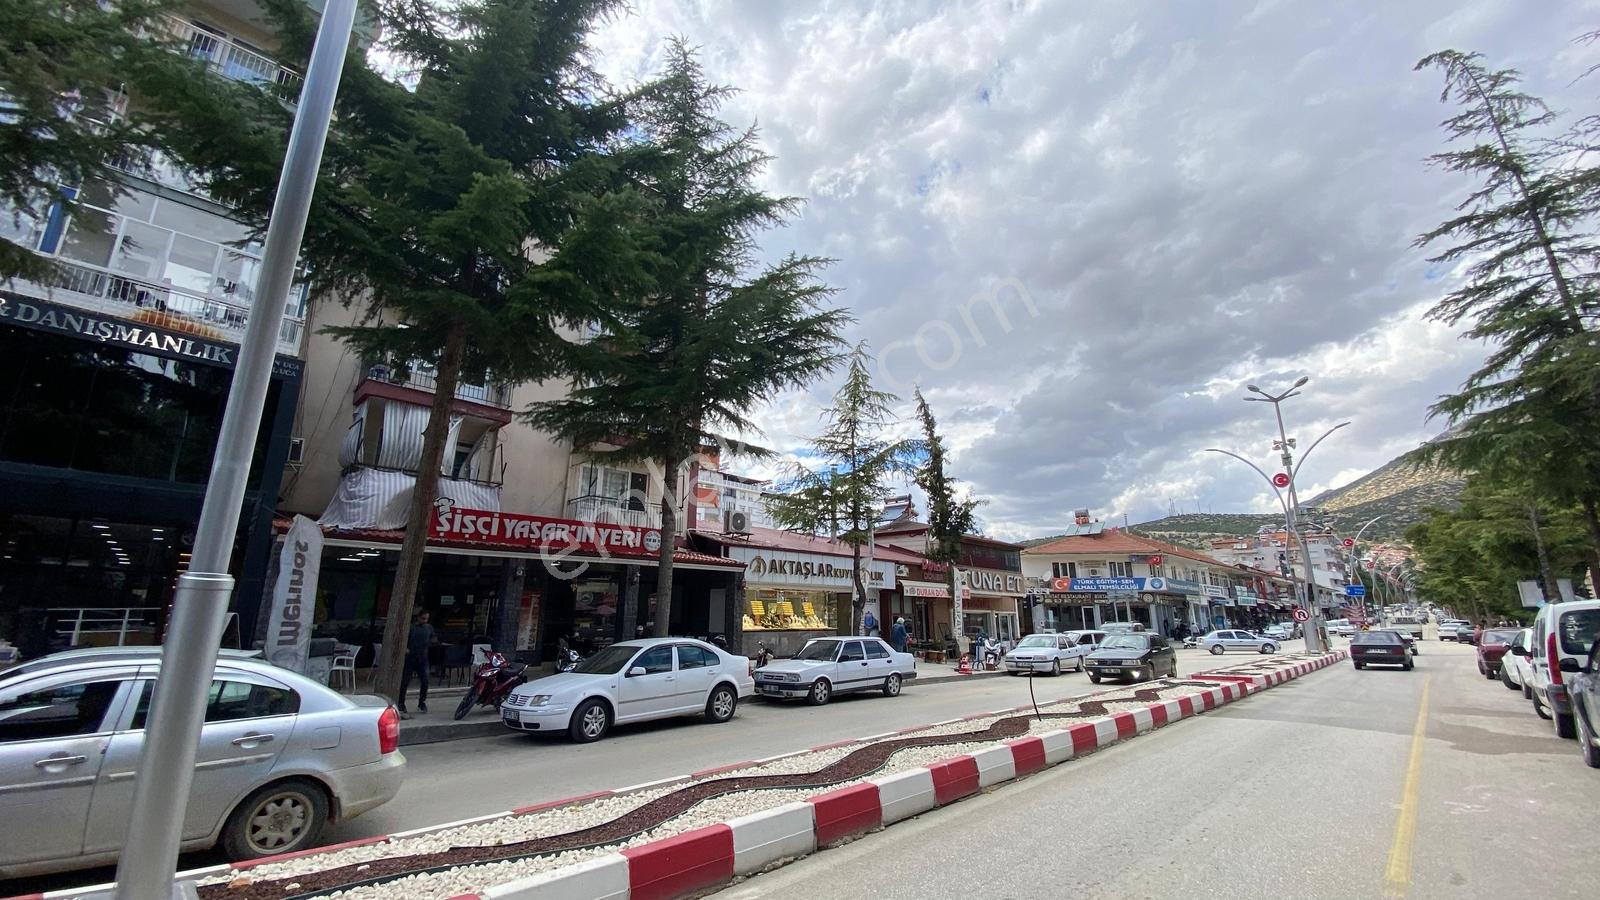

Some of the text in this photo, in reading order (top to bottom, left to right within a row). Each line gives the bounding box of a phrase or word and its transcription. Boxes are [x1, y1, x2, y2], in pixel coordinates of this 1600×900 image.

[13, 303, 233, 364] DANIŞMANLIK
[436, 508, 499, 540] ŞİŞÇİ
[504, 518, 595, 543] YAŞAR'IN
[600, 528, 642, 549] YERİ
[768, 559, 833, 580] AKTAŞLAR
[1006, 575, 1022, 592] ET
